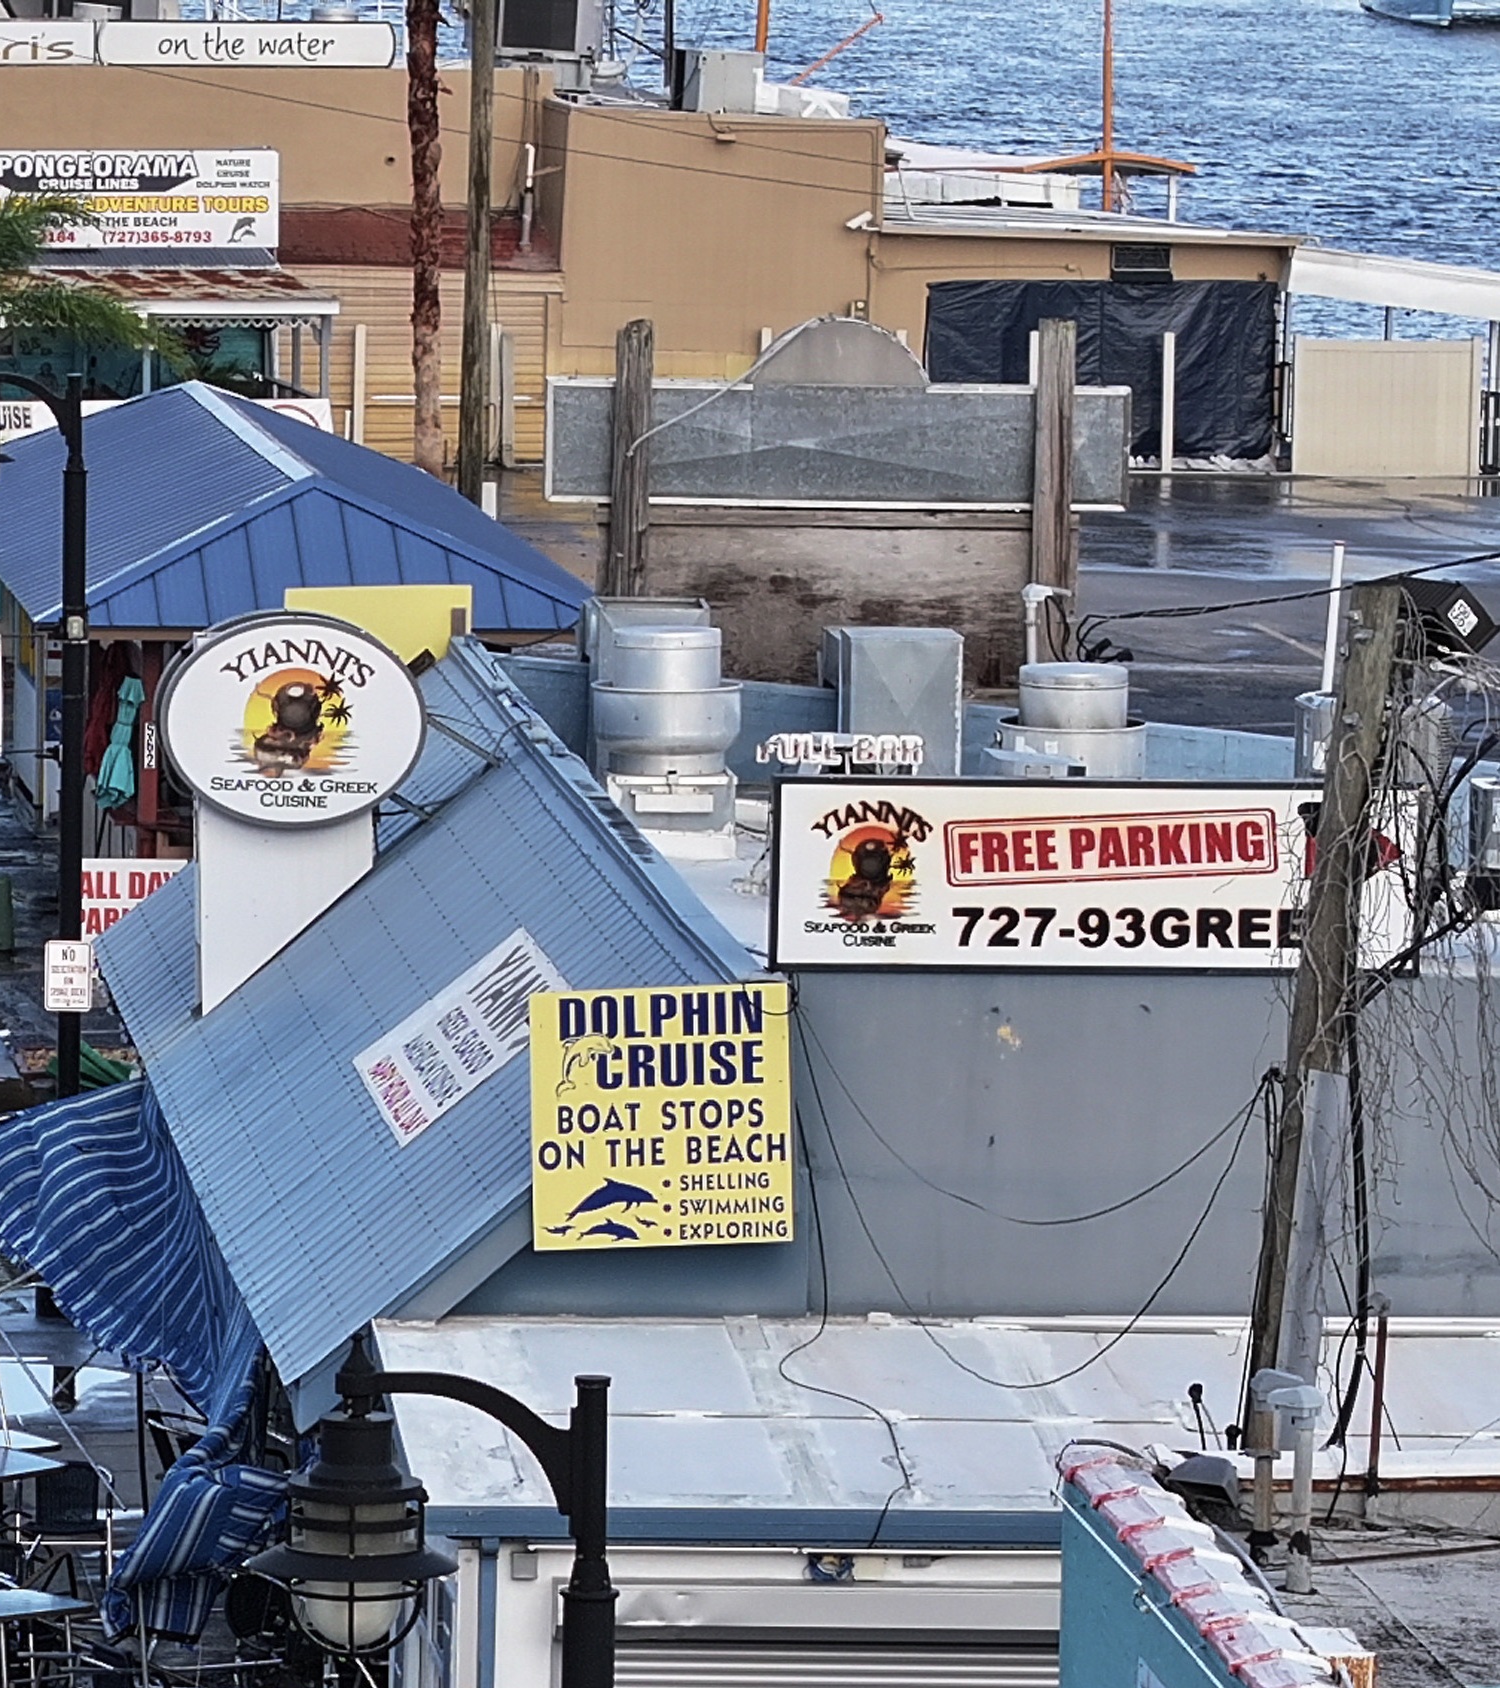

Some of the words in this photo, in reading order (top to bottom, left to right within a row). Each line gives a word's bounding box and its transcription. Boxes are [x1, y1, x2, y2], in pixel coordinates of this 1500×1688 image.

[157, 36, 200, 61] on
[202, 27, 246, 59] the
[257, 28, 336, 62] water
[37, 178, 93, 190] CRUISE
[96, 178, 139, 190] LINES
[202, 196, 269, 213] TOURS
[105, 217, 130, 227] THE
[134, 216, 178, 227] BEACH
[220, 639, 376, 688] YIANNI'S
[210, 777, 294, 792] SEAFOOD
[297, 778, 316, 793] &
[319, 779, 378, 794] GREEK
[259, 793, 328, 808] CUISINE
[810, 799, 934, 843] YIANNI'S
[957, 829, 1059, 875] FREE
[1069, 820, 1266, 870] PARKING
[81, 871, 121, 900] ALL
[803, 921, 869, 934] SEAFOOD
[872, 922, 887, 934] &
[889, 921, 936, 934] GREEK
[842, 935, 897, 948] CUISINE
[62, 949, 76, 961] NO
[558, 990, 764, 1041] DOLPHIN
[596, 1040, 764, 1090] CRUISE
[557, 1102, 640, 1134] BOAT
[661, 1098, 764, 1131] STOPS
[538, 1140, 586, 1170] ON
[605, 1136, 666, 1168] THE
[686, 1133, 787, 1164] BEACH
[679, 1172, 770, 1191] SHELLING
[679, 1196, 785, 1215] SWIMMING
[679, 1220, 788, 1240] EXPLORING
